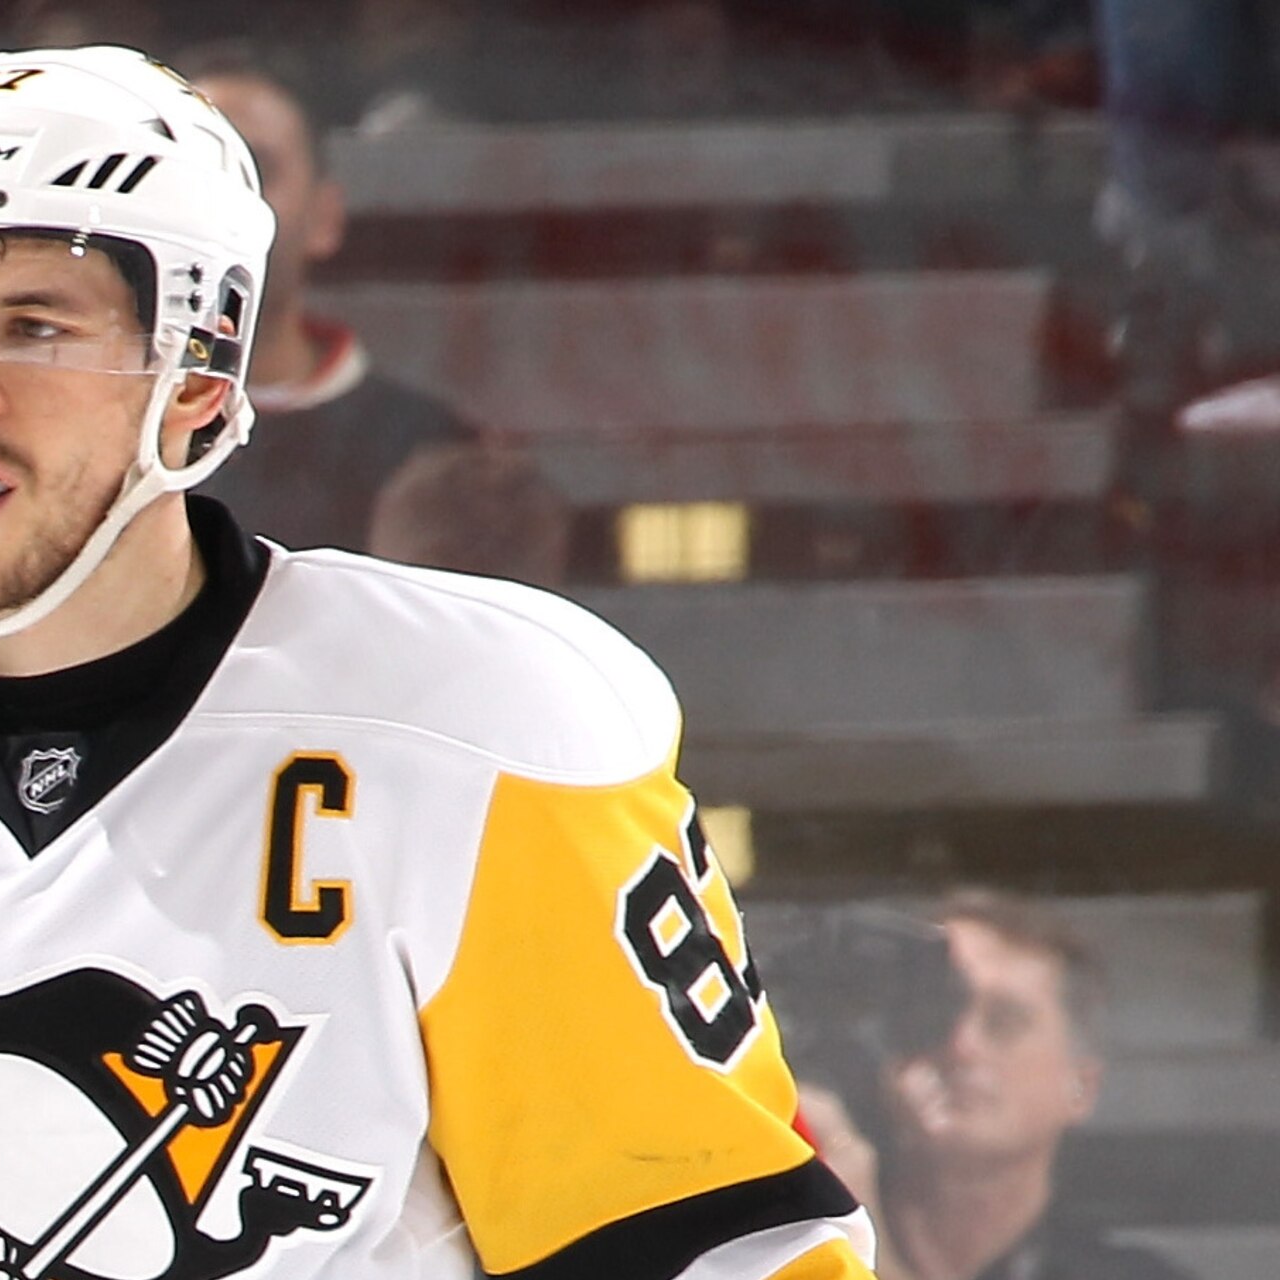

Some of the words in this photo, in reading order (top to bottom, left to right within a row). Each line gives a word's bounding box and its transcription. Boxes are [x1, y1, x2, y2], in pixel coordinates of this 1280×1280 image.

[31, 764, 67, 797] NHL
[262, 750, 355, 945] C
[614, 790, 768, 1076] 8
